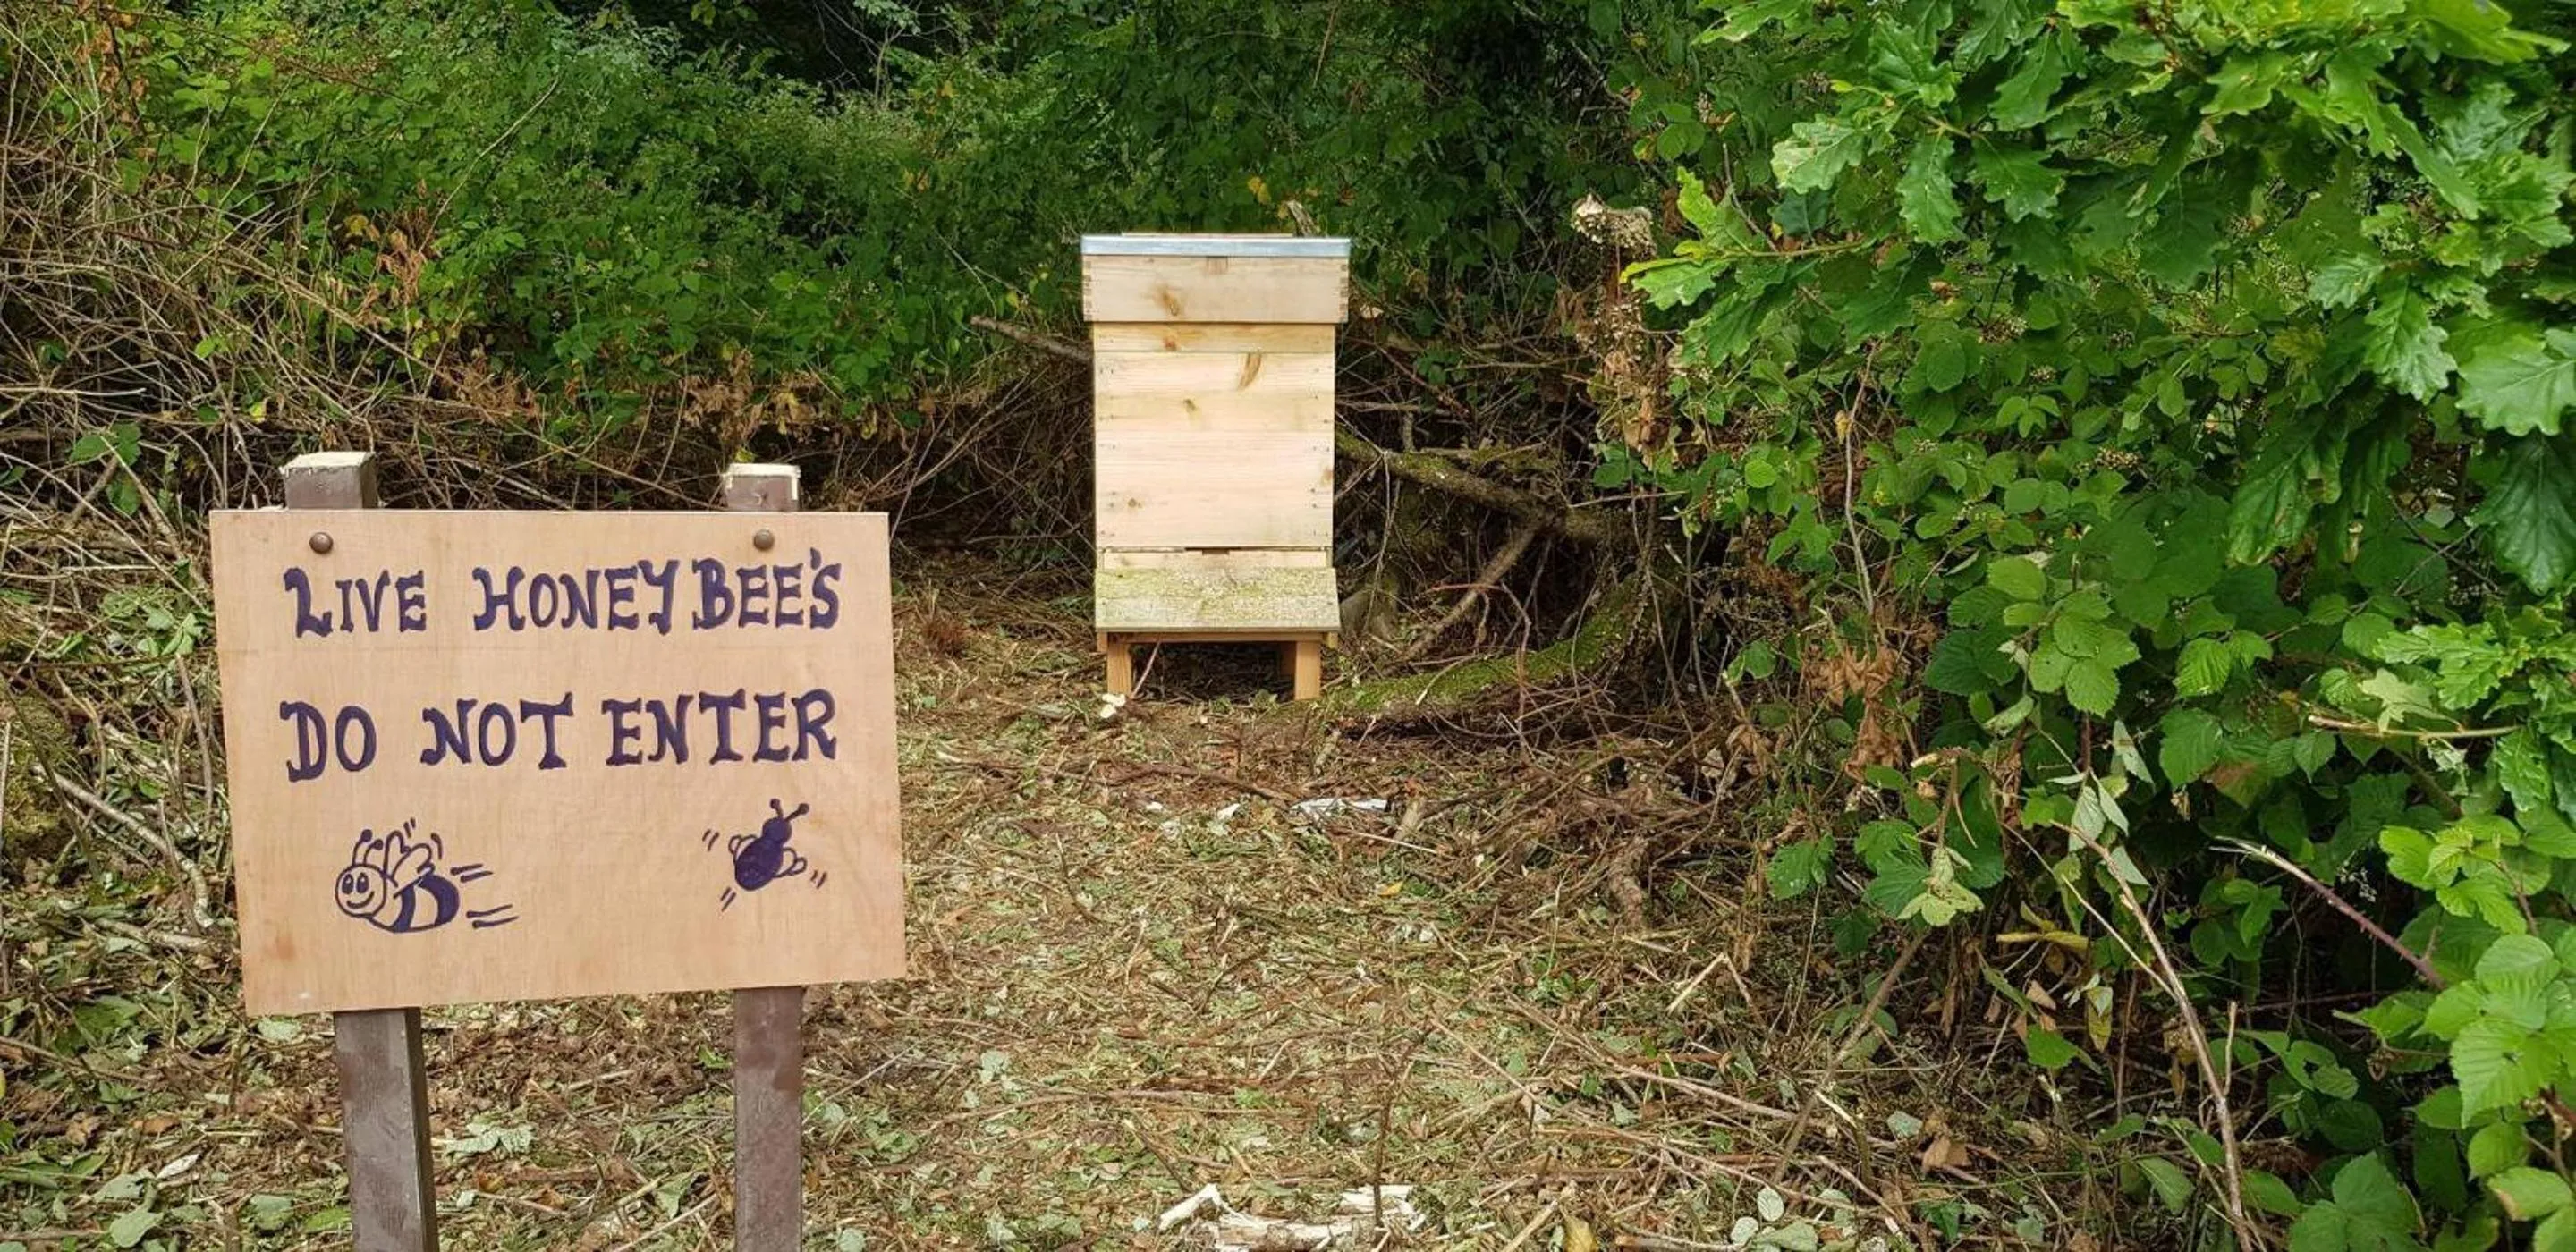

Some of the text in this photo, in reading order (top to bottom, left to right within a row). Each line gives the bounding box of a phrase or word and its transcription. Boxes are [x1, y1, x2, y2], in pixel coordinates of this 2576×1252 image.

[283, 547, 841, 639] LIVE HONEY BEE'S
[279, 688, 837, 783] DO NOT ENTER
